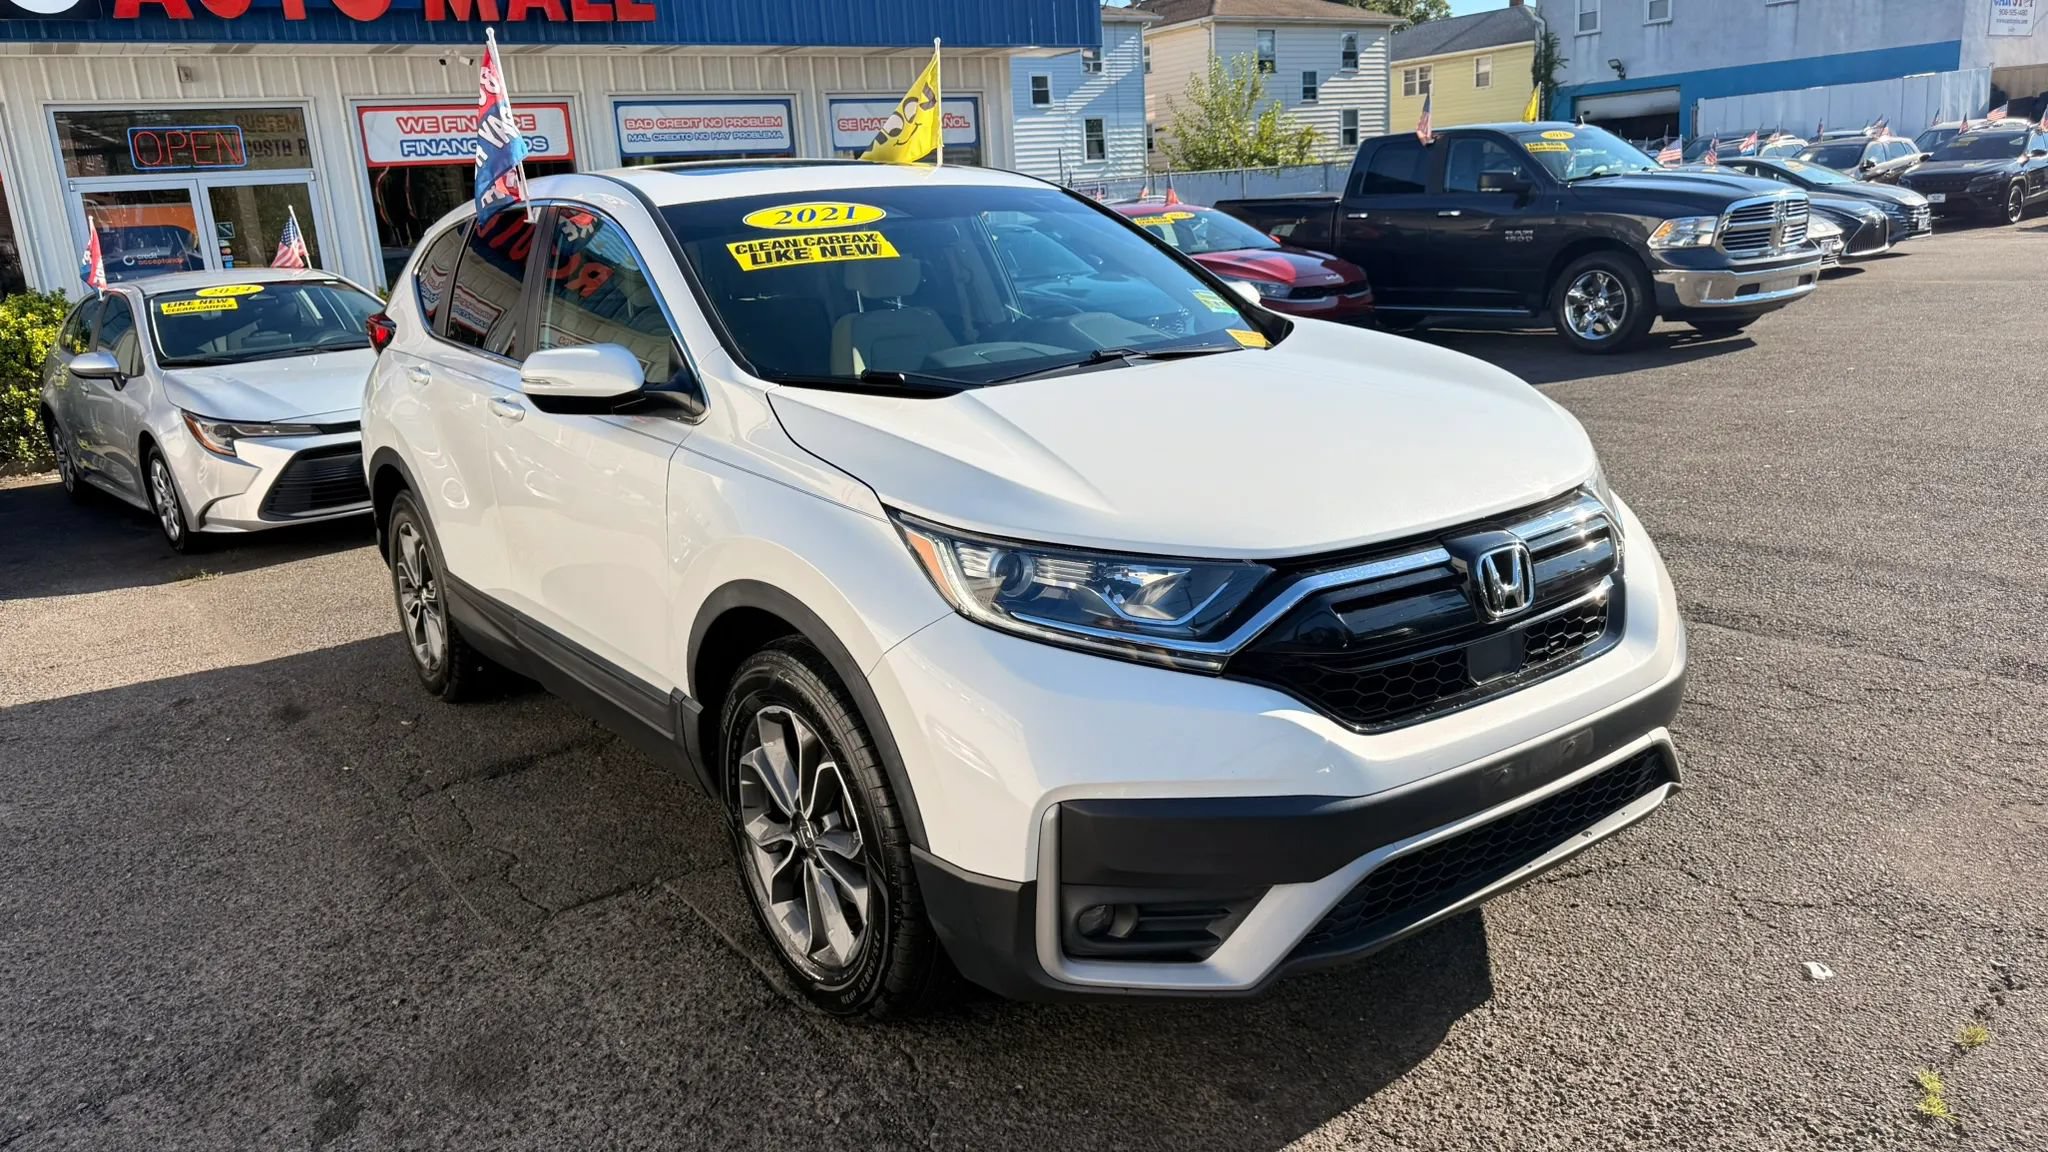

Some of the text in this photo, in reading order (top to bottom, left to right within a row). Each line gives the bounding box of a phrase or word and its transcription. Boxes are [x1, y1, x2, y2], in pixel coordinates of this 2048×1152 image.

[396, 114, 536, 134] WE FINCE
[624, 116, 783, 130] BAD CREDIT NO PROBLEM
[838, 118, 857, 131] SE
[400, 136, 549, 157] FINANCS
[628, 130, 784, 143] MAL CREDITO NO HAY PROBLEMA
[133, 131, 245, 166] OPEN
[774, 206, 857, 225] 2021
[735, 233, 879, 255] CLEAN CARFAX
[750, 243, 881, 266] LIKE NEW
